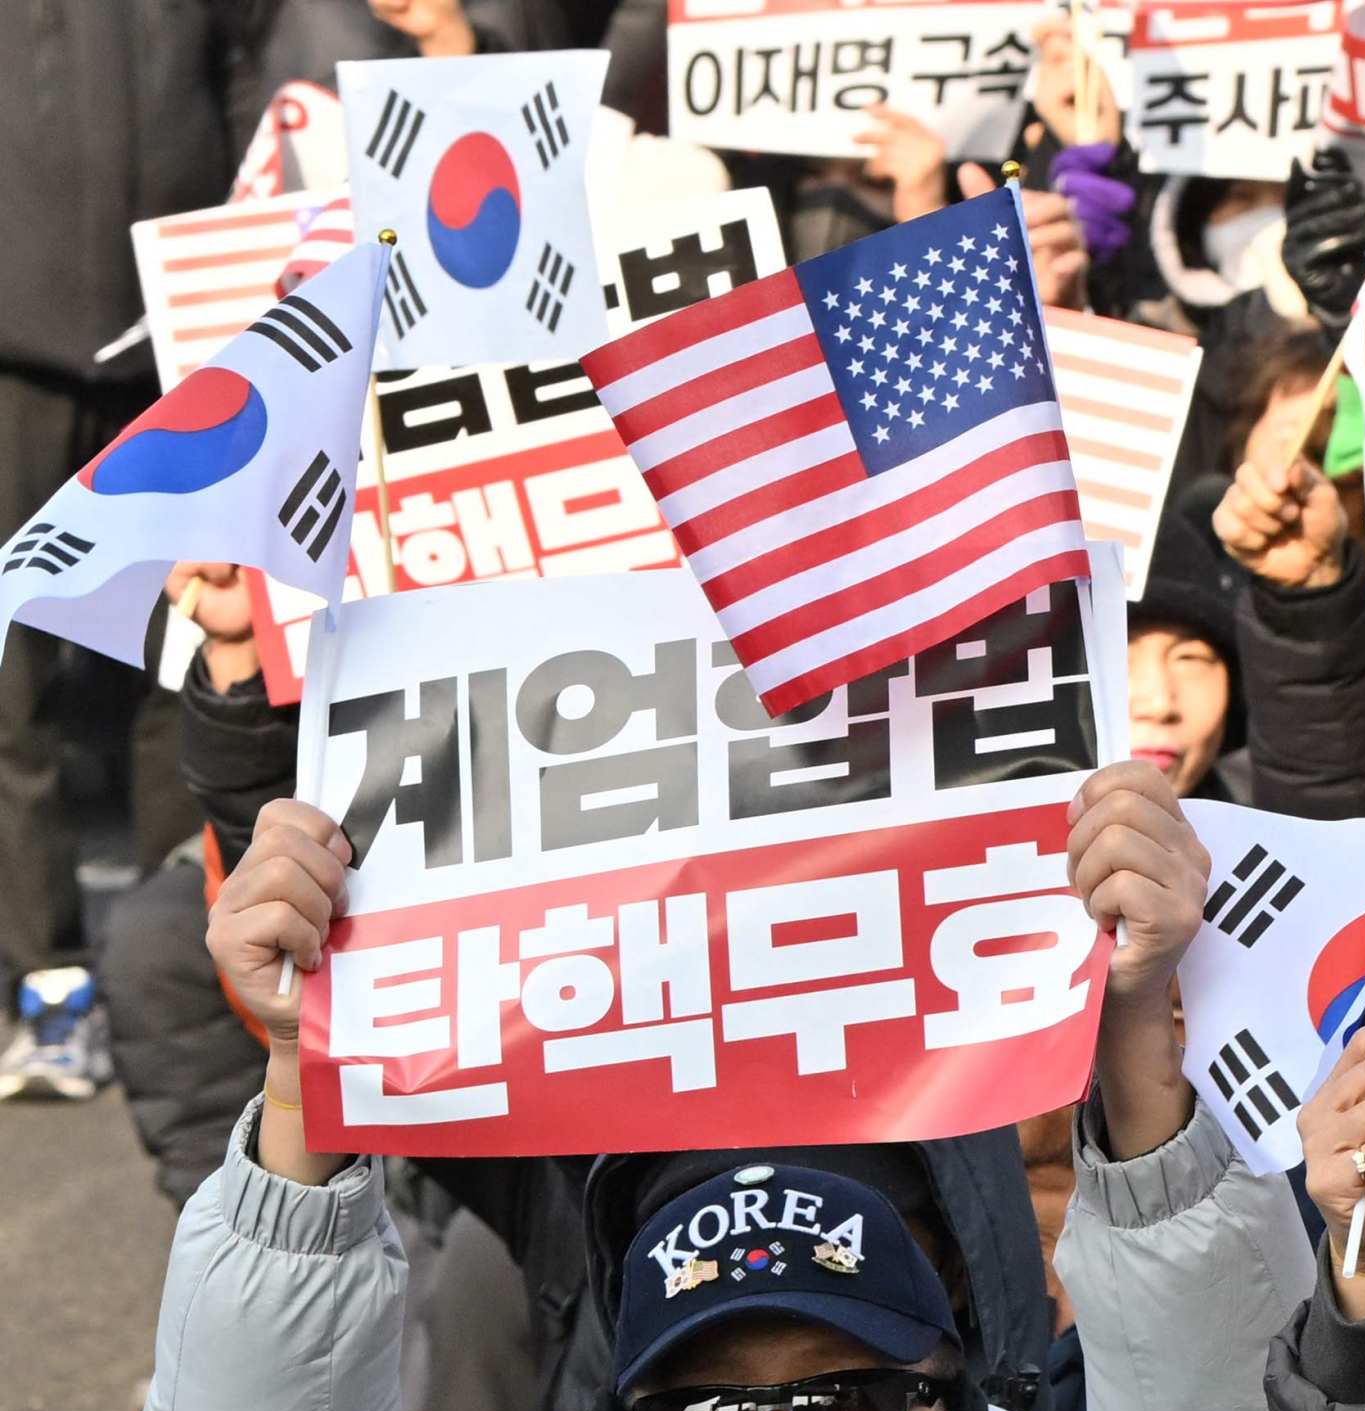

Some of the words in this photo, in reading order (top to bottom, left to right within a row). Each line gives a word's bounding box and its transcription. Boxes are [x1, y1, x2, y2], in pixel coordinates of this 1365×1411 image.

[685, 38, 893, 116] 이재명
[912, 31, 1031, 106] 구속
[328, 840, 1100, 1128] 탄핵무효
[648, 1188, 865, 1279] KOREA
